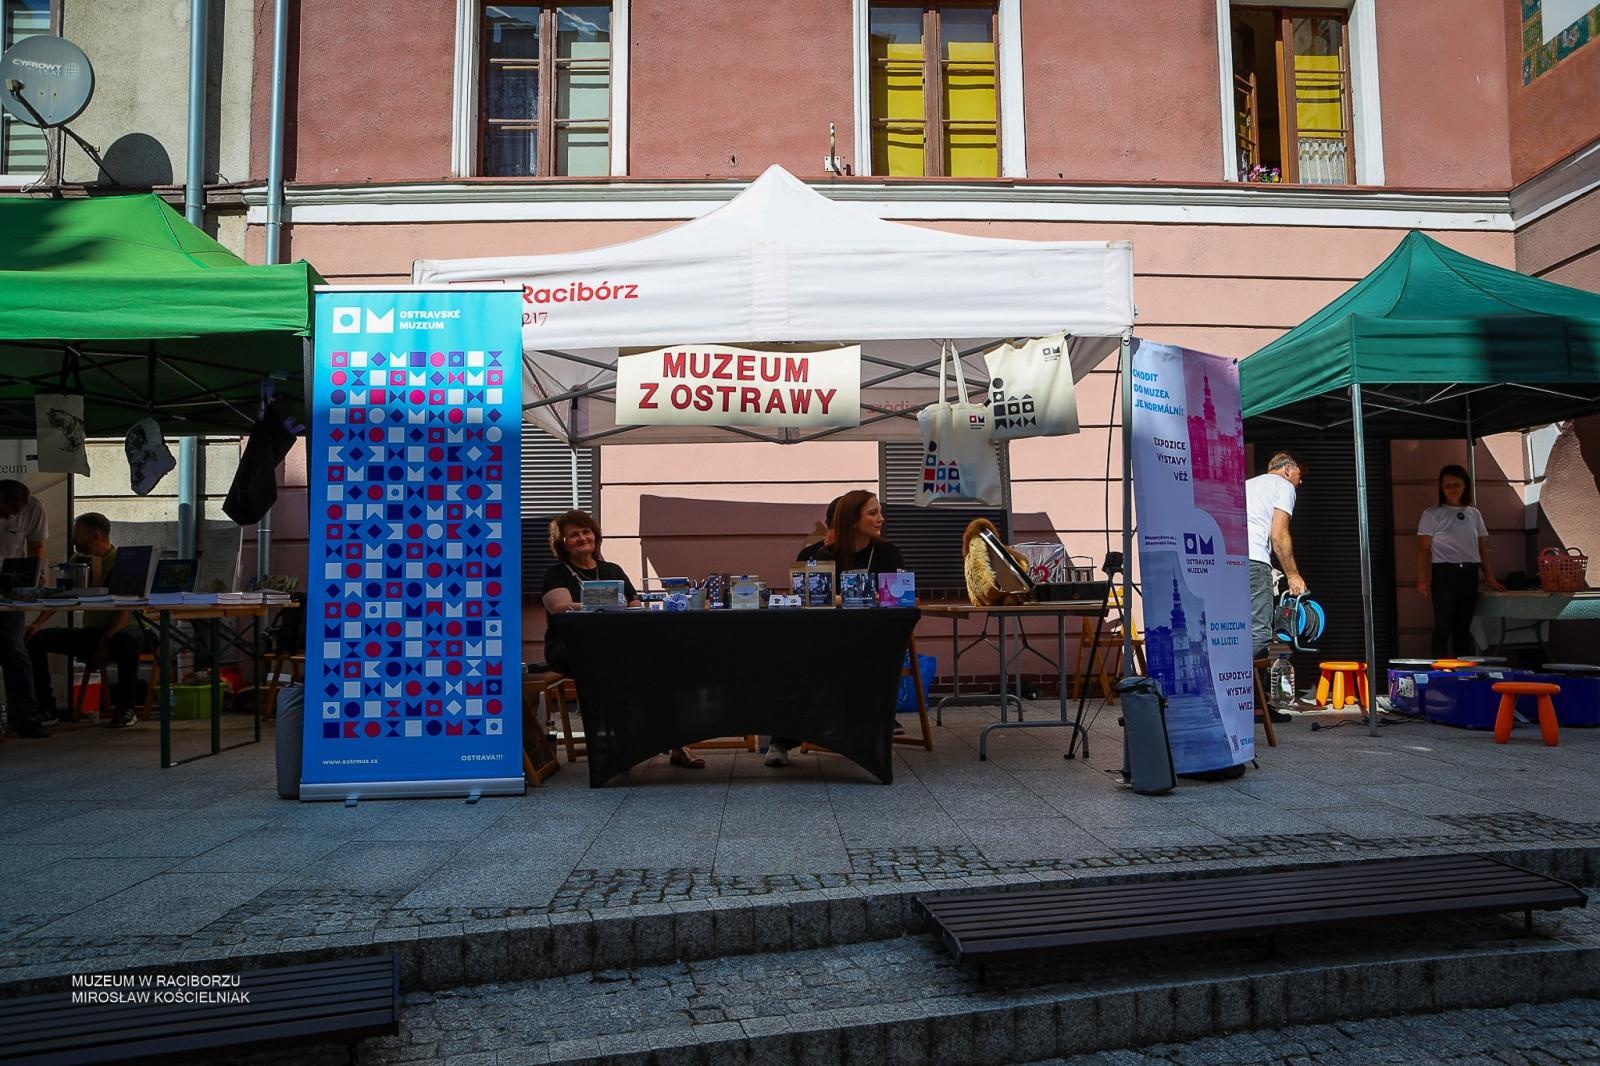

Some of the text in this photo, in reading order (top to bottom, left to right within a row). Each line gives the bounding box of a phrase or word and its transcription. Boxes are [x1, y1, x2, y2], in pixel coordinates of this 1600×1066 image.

[12, 58, 62, 71] CYFROWY
[522, 281, 639, 304] Racibórz
[399, 309, 461, 319] OSTRAVSKÉ
[399, 321, 445, 330] MUZEUM
[662, 352, 809, 383] MUZEUM
[1132, 368, 1158, 383] CHODIT
[1133, 383, 1170, 399] DO MUZEA
[638, 382, 660, 410] Z
[670, 384, 837, 415] OSTRAWY
[1134, 398, 1144, 408] JE
[1153, 437, 1187, 450] EXPOZICE
[1210, 621, 1246, 631] DO MUZEUM
[1211, 637, 1221, 646] NA
[460, 753, 503, 762] OSTRAVA!!!
